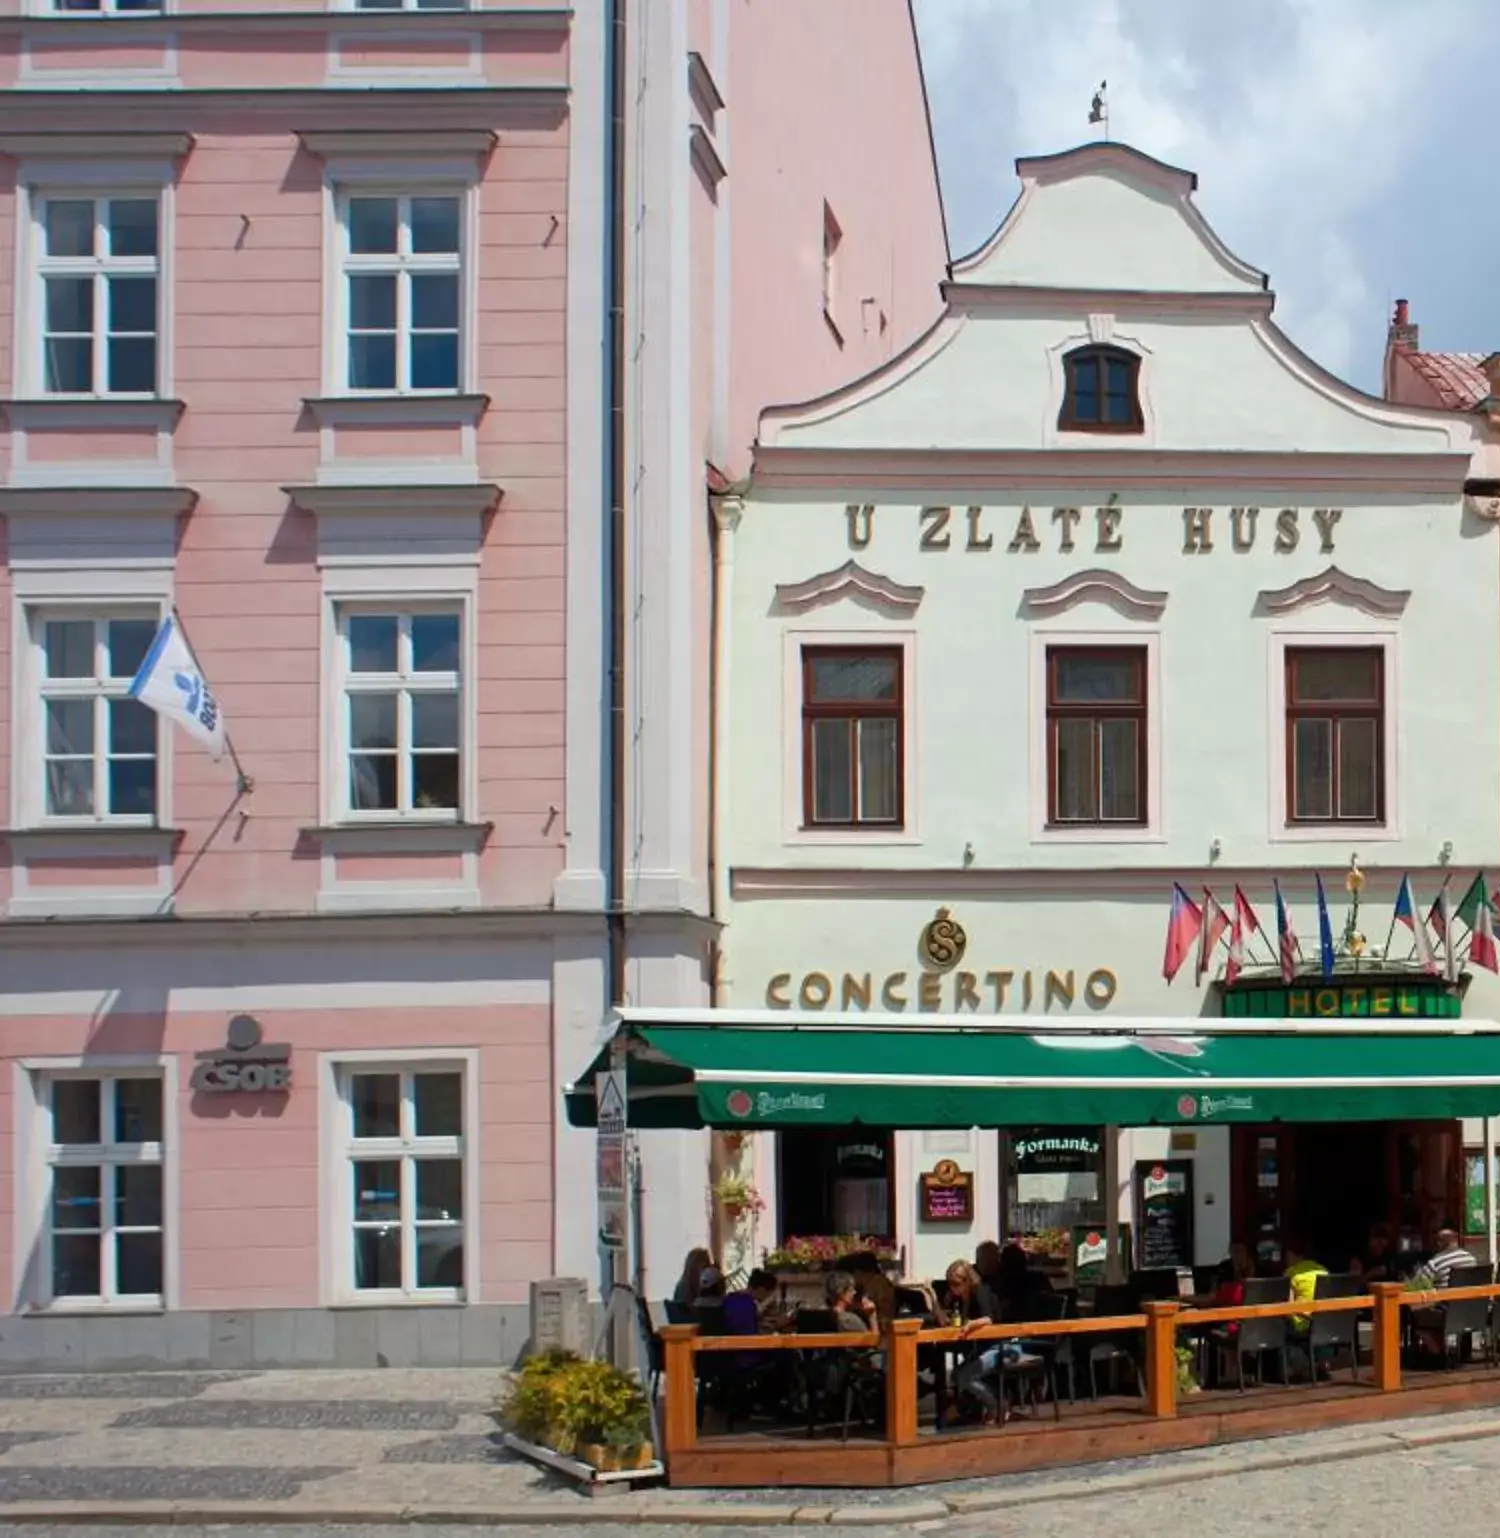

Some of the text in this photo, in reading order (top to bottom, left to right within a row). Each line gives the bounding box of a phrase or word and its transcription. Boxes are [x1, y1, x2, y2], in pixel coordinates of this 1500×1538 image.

[845, 493, 1343, 555] U ZLATÉ HUSY
[765, 968, 1118, 1013] CONCERTINO
[1288, 978, 1419, 1016] HOTEL
